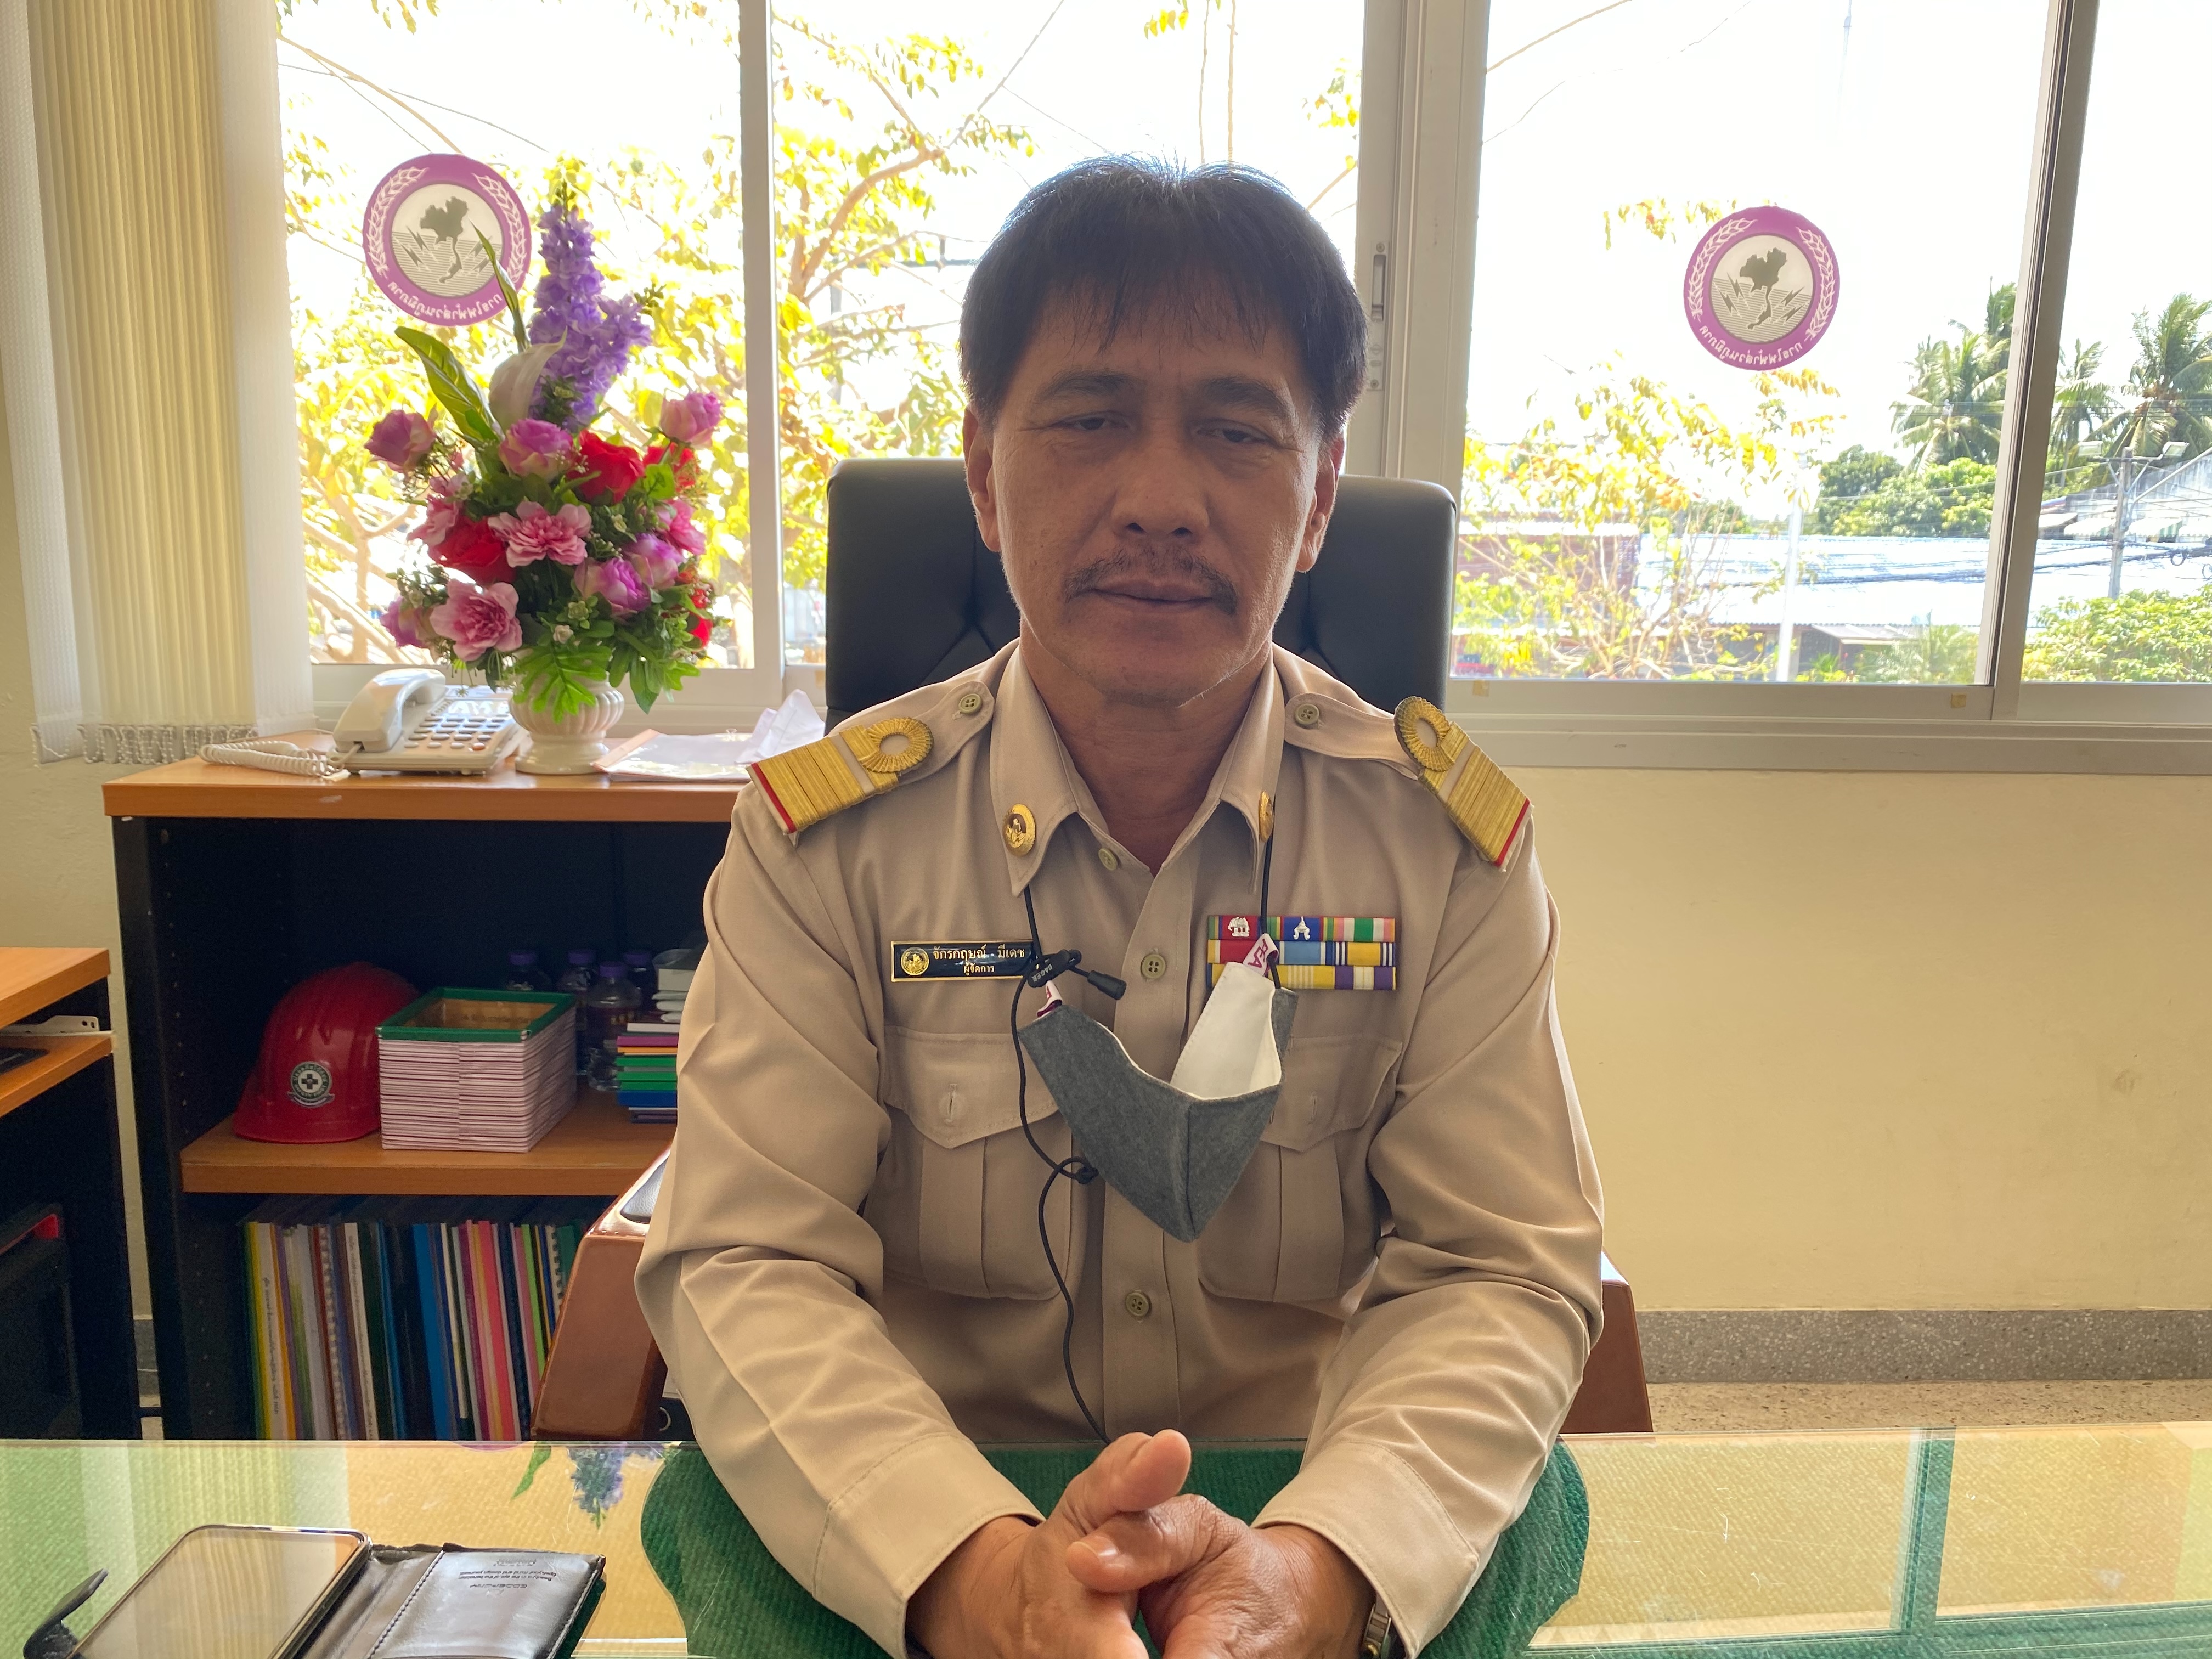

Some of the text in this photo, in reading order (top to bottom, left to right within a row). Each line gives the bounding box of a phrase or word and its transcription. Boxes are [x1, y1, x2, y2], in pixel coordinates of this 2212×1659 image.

[933, 944, 1025, 961] จักรกฤษณ์ มีเดช
[963, 962, 995, 976] ผู้จัดการ
